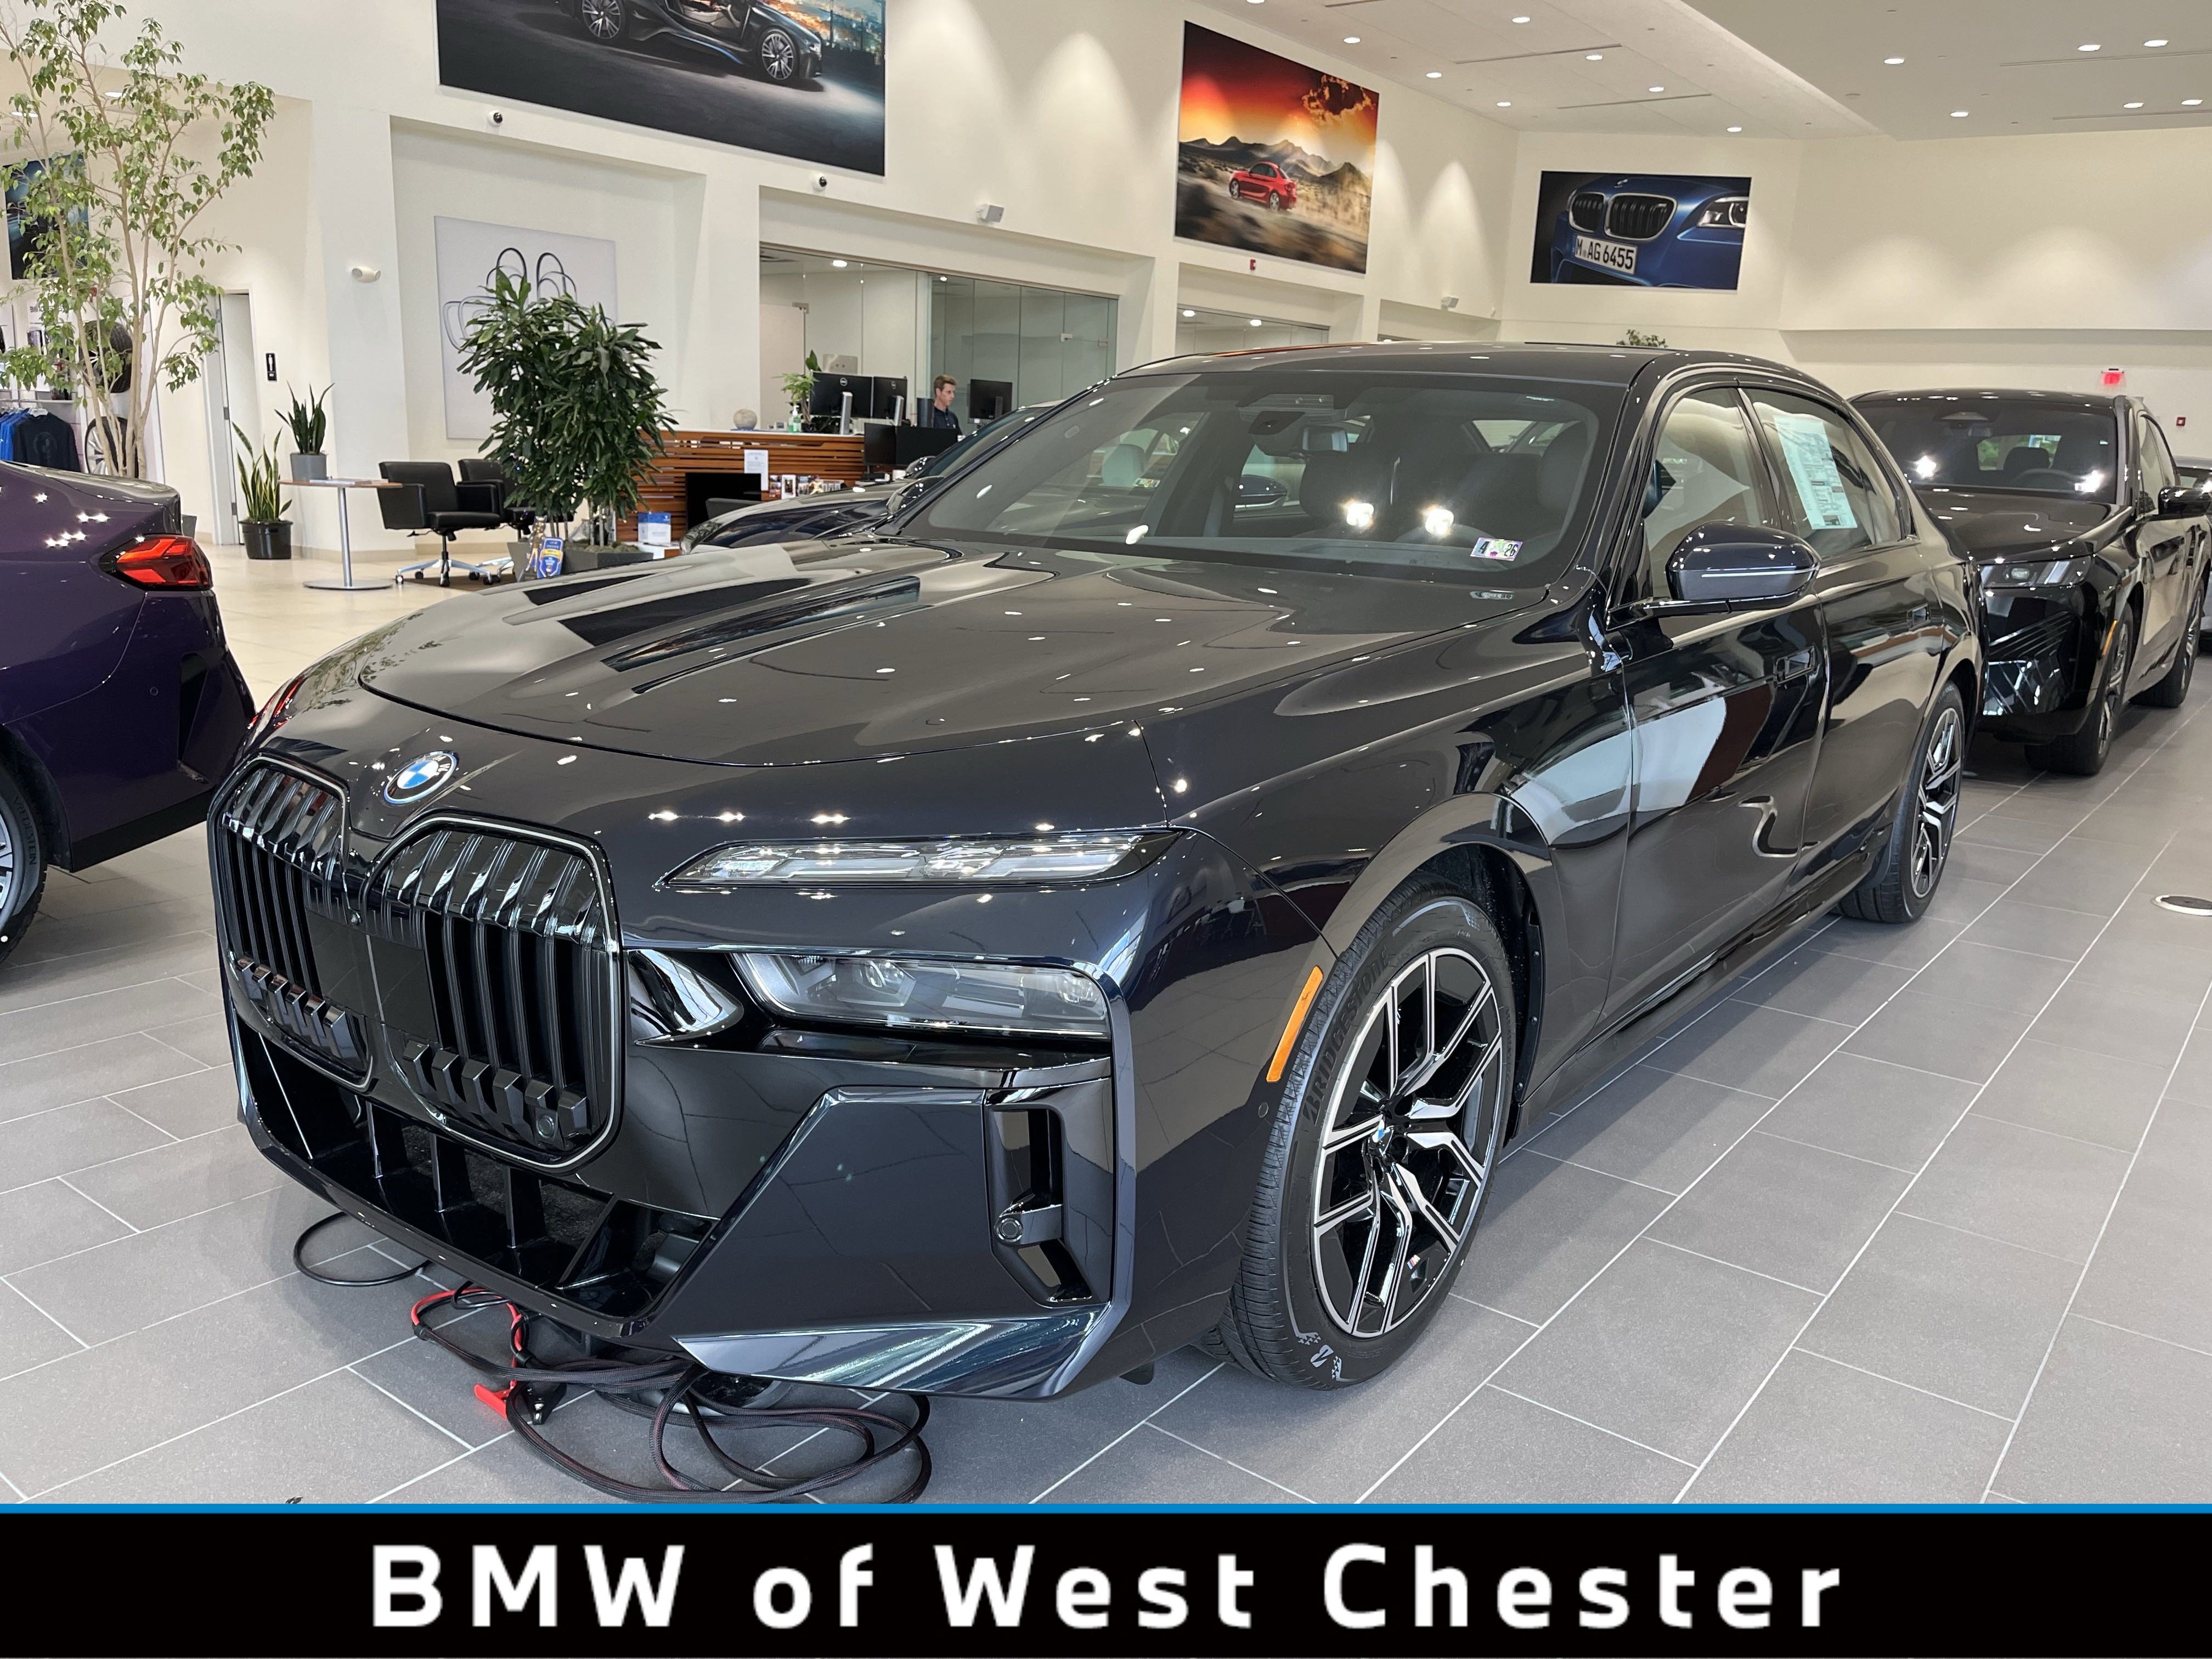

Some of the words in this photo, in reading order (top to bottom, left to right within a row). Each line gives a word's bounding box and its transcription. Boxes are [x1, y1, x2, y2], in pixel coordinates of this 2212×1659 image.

[1575, 238, 1583, 256] M
[1587, 241, 1601, 262] AG
[1602, 245, 1635, 270] 6455
[1478, 541, 1490, 554] 4
[1504, 544, 1519, 557] 26
